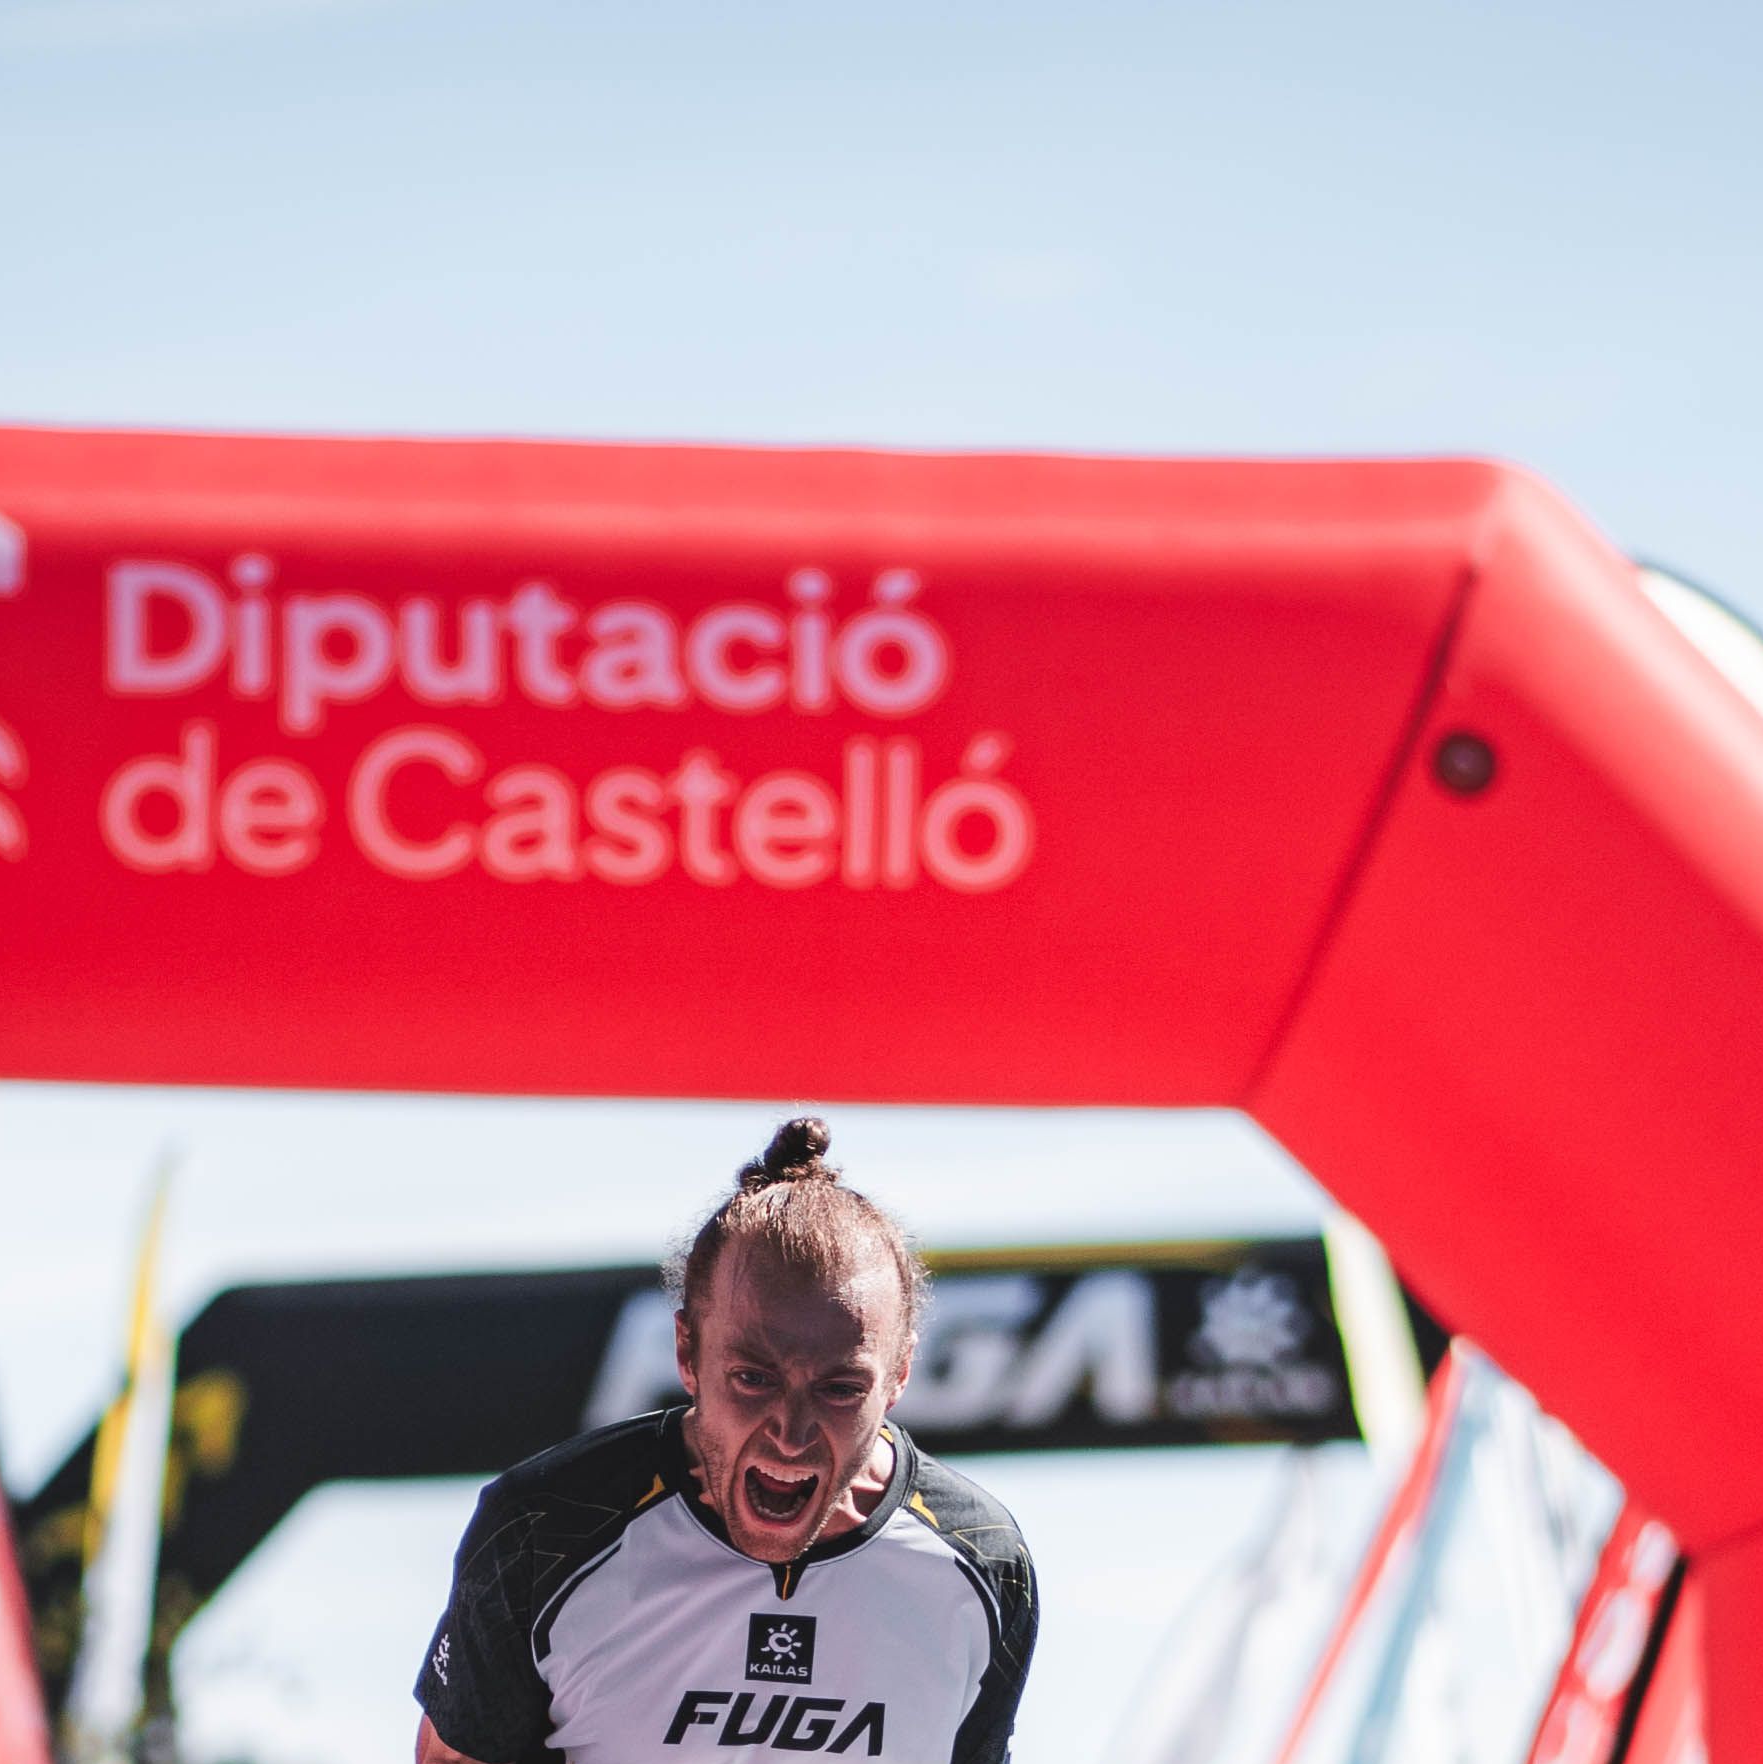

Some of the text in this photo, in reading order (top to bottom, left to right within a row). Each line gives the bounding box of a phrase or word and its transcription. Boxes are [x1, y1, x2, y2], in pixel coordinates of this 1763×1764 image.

[105, 554, 949, 737] Diputació
[99, 719, 1032, 893] de Castelló
[664, 1690, 885, 1757] FUGA
[749, 1663, 809, 1678] KAILAS
